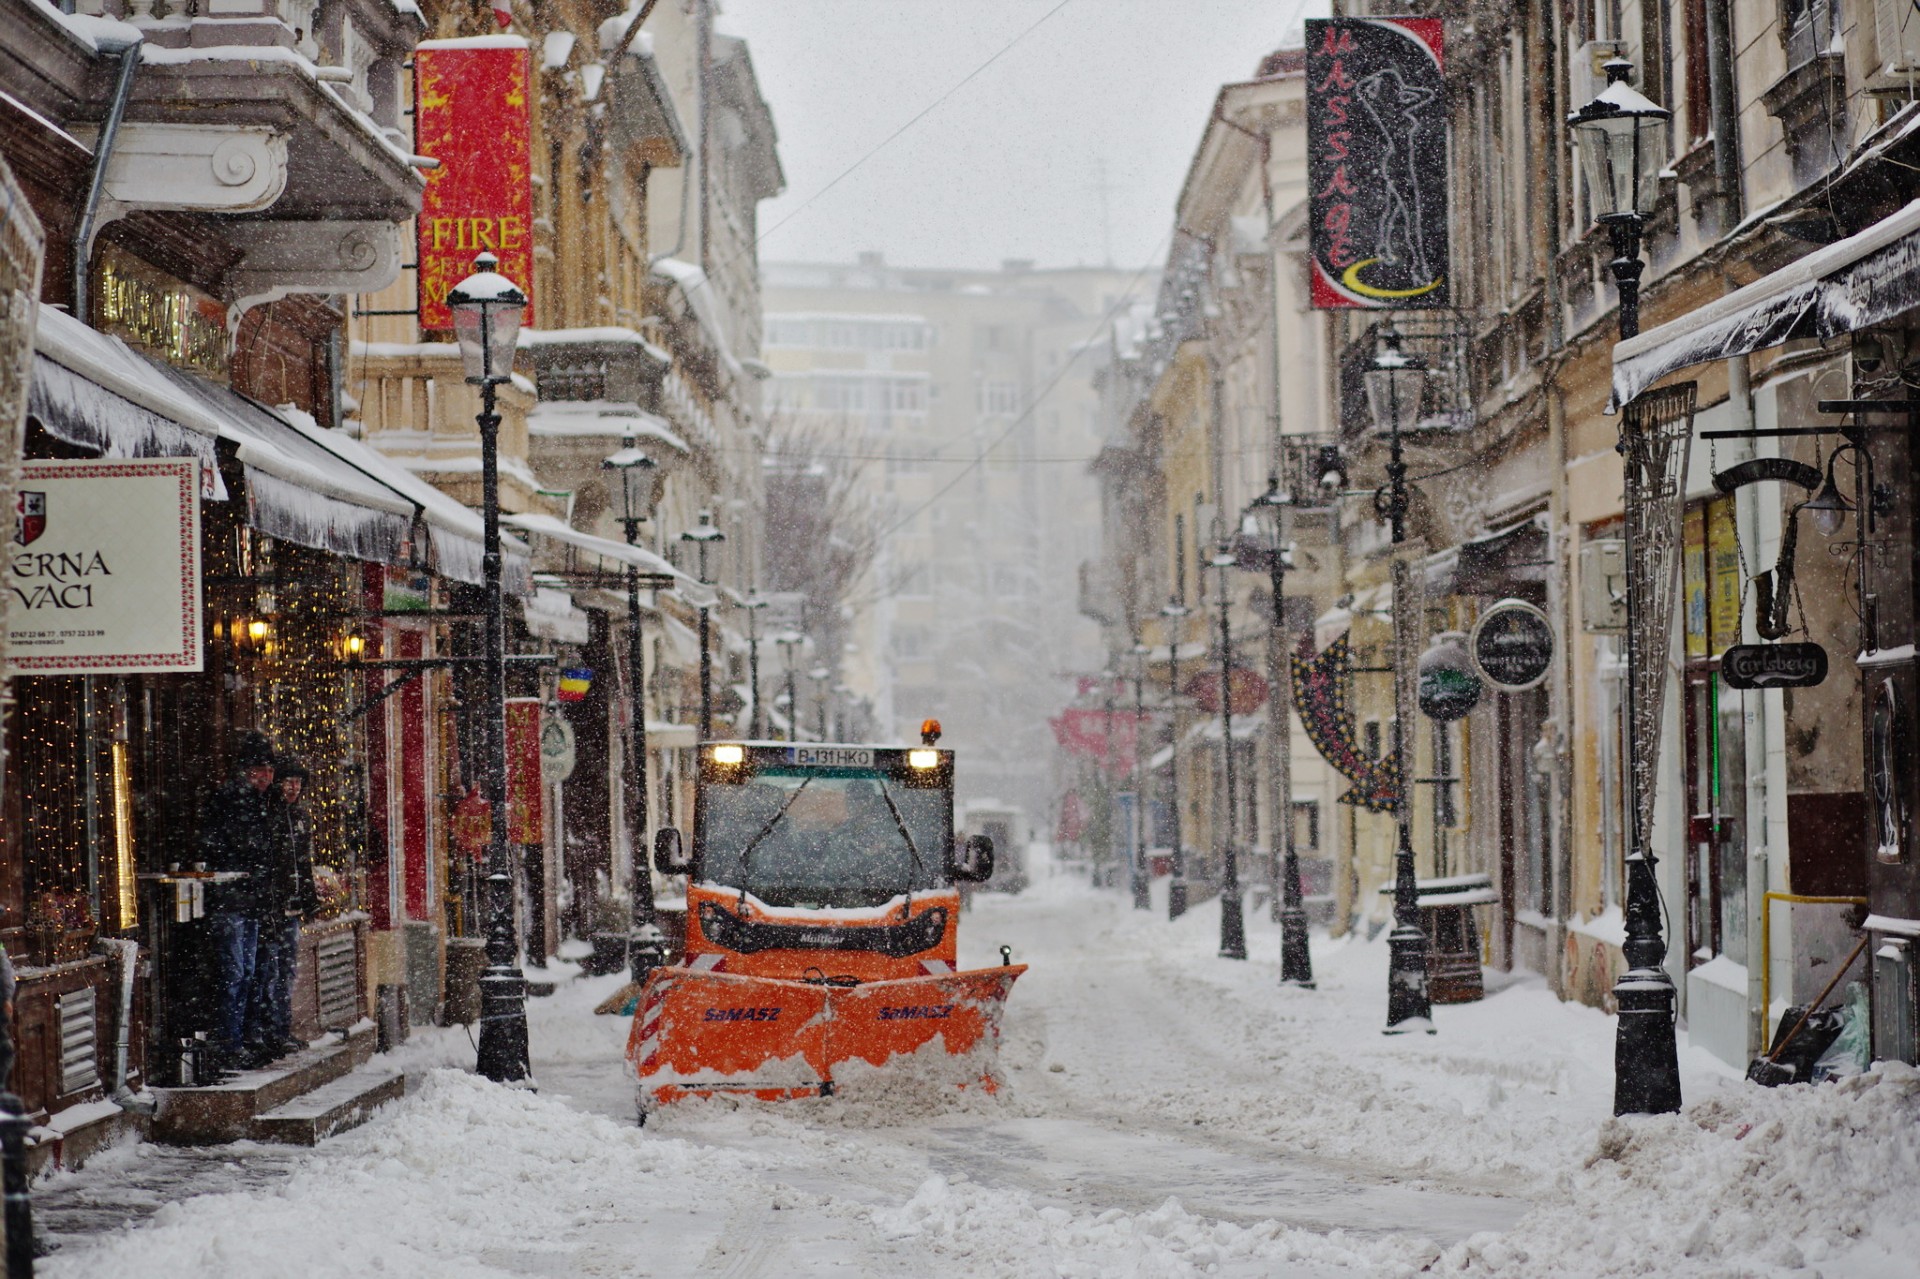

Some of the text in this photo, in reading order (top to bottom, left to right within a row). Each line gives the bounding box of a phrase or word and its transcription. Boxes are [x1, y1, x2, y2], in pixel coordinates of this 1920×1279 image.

[431, 216, 522, 250] FIRE
[1732, 650, 1817, 679] Carlsberg
[798, 749, 809, 764] B
[800, 933, 845, 945] Multicar
[703, 1007, 782, 1022] SaMASZ
[876, 1004, 954, 1020] SaMASZ
